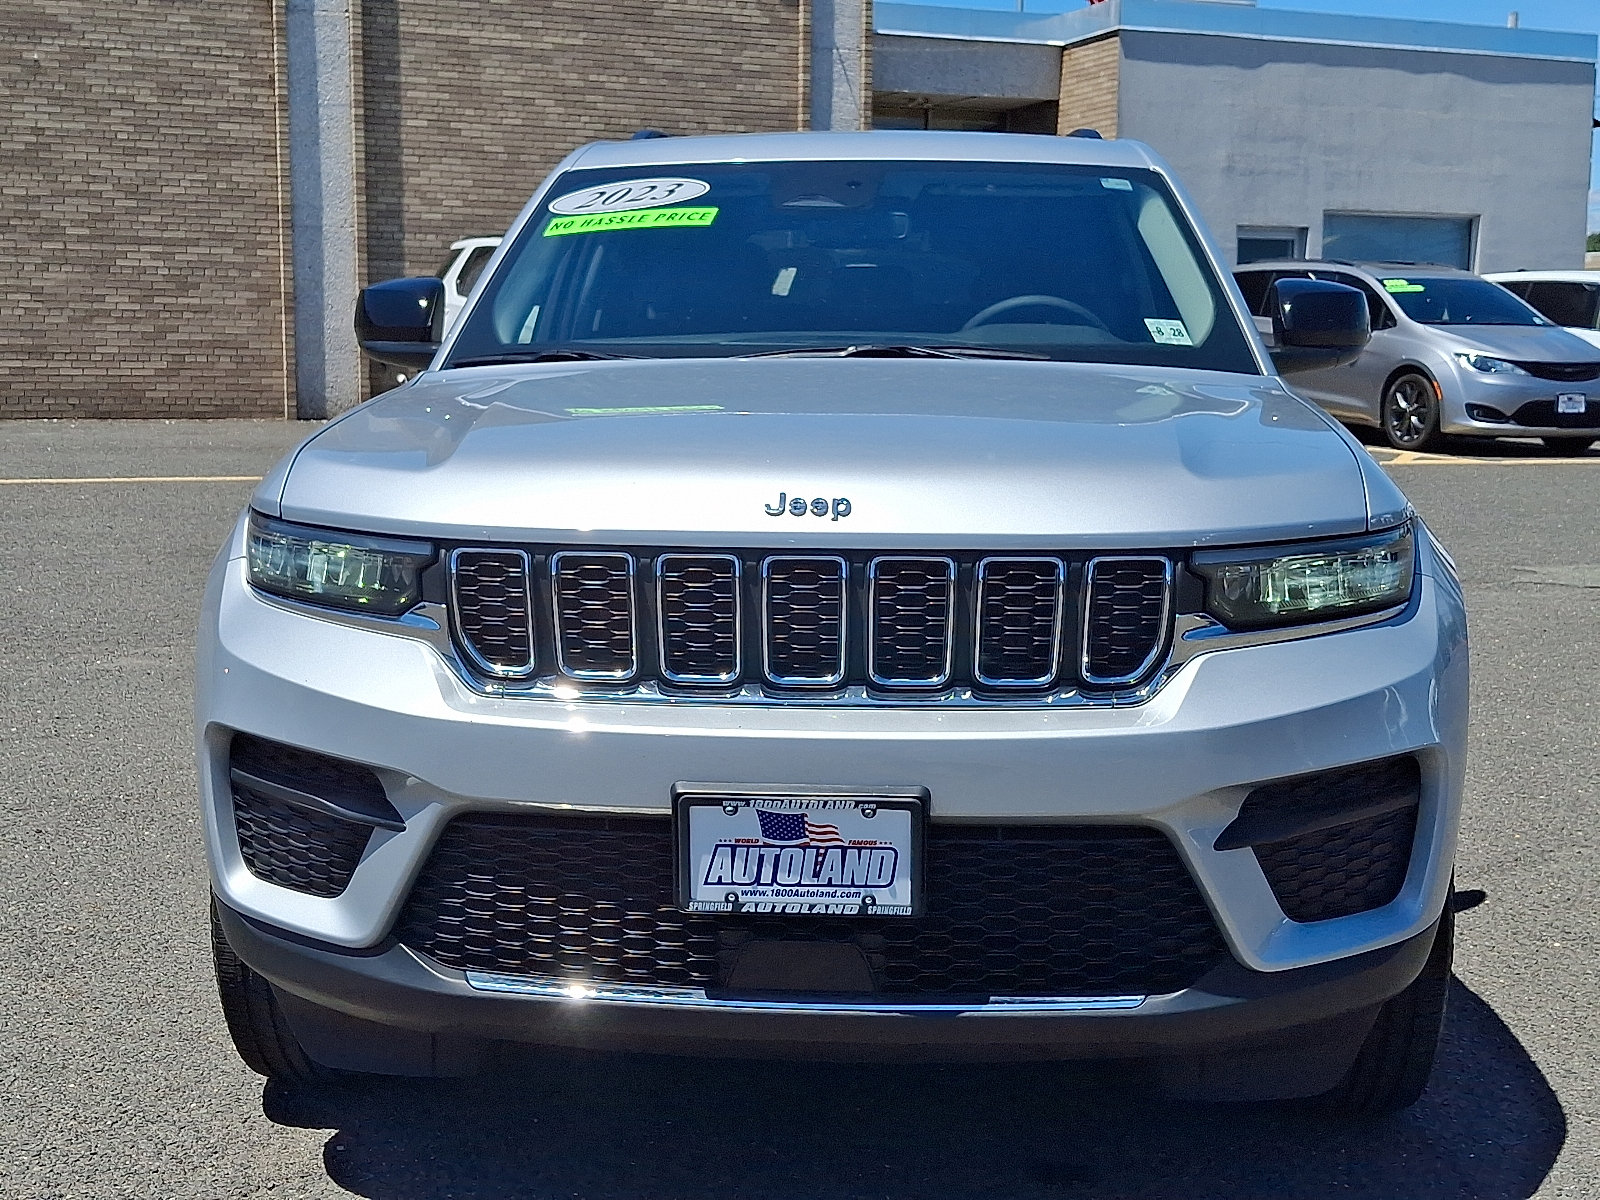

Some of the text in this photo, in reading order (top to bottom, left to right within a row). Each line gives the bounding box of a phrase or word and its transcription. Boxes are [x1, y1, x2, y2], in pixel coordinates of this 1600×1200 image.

[572, 183, 685, 210] 2023
[549, 211, 712, 231] NO HASSLE PRICE
[1170, 328, 1184, 337] 28
[764, 492, 852, 522] Jeep
[704, 845, 898, 887] AUTOLAND
[740, 888, 862, 899] www.1800Autoland.com
[688, 901, 913, 916] SPRINGFIELD AUTOLAND SPRINGFIELD
